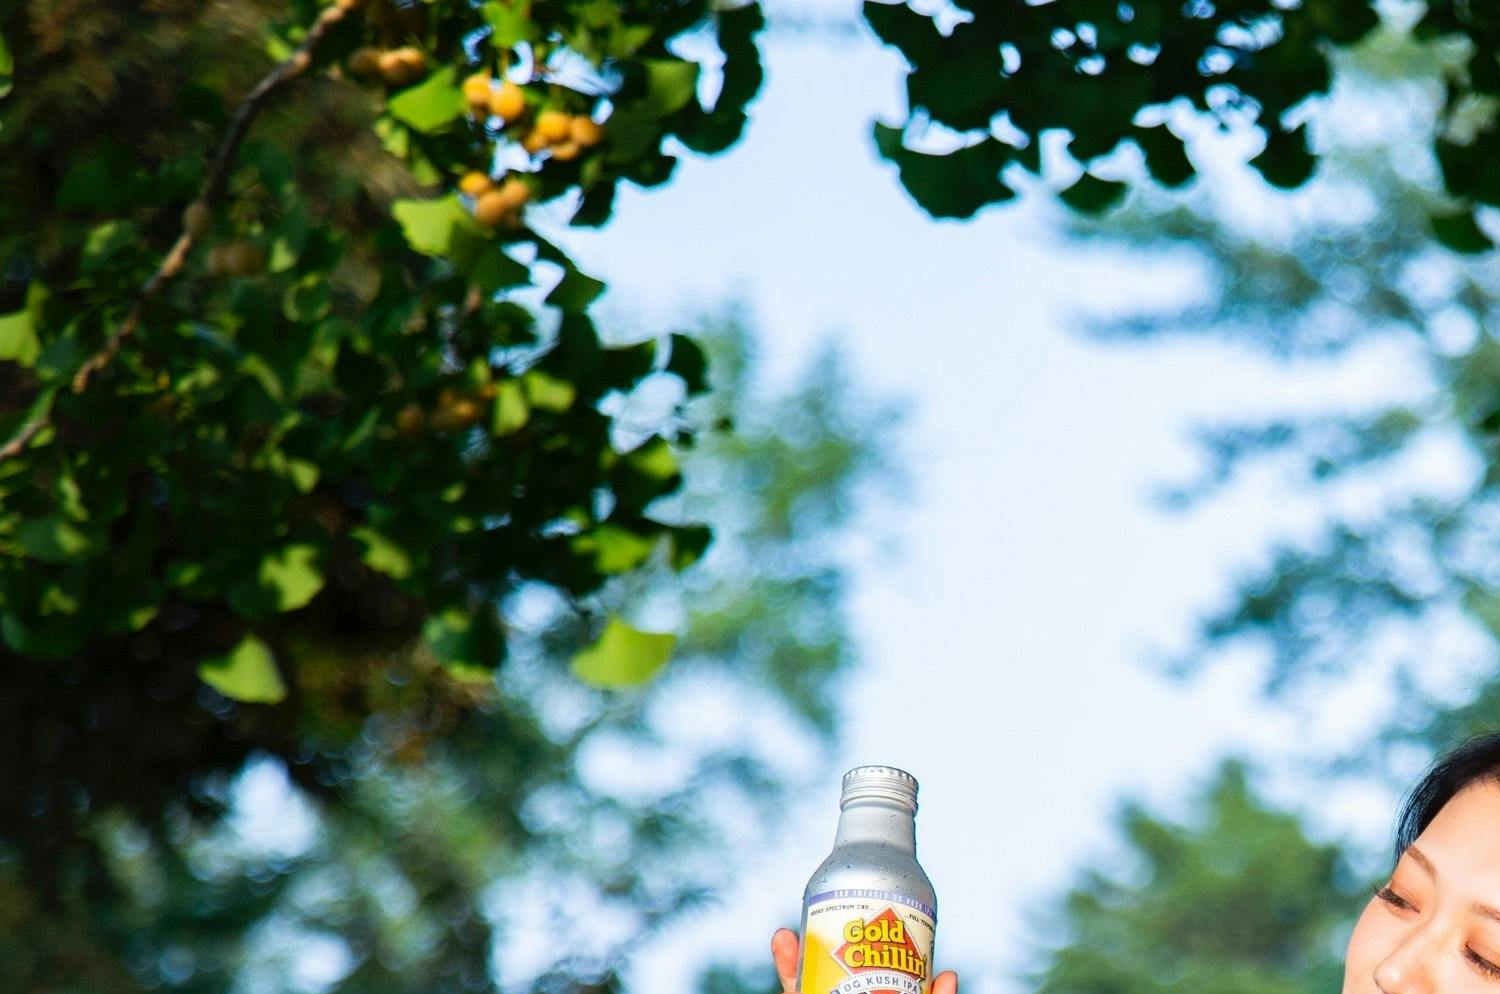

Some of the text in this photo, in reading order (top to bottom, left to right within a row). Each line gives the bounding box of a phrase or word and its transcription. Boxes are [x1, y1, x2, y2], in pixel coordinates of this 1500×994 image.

[825, 904, 855, 912] SPECTRUM
[843, 917, 907, 944] Gold
[844, 976, 918, 994] OG KUSH IPA
